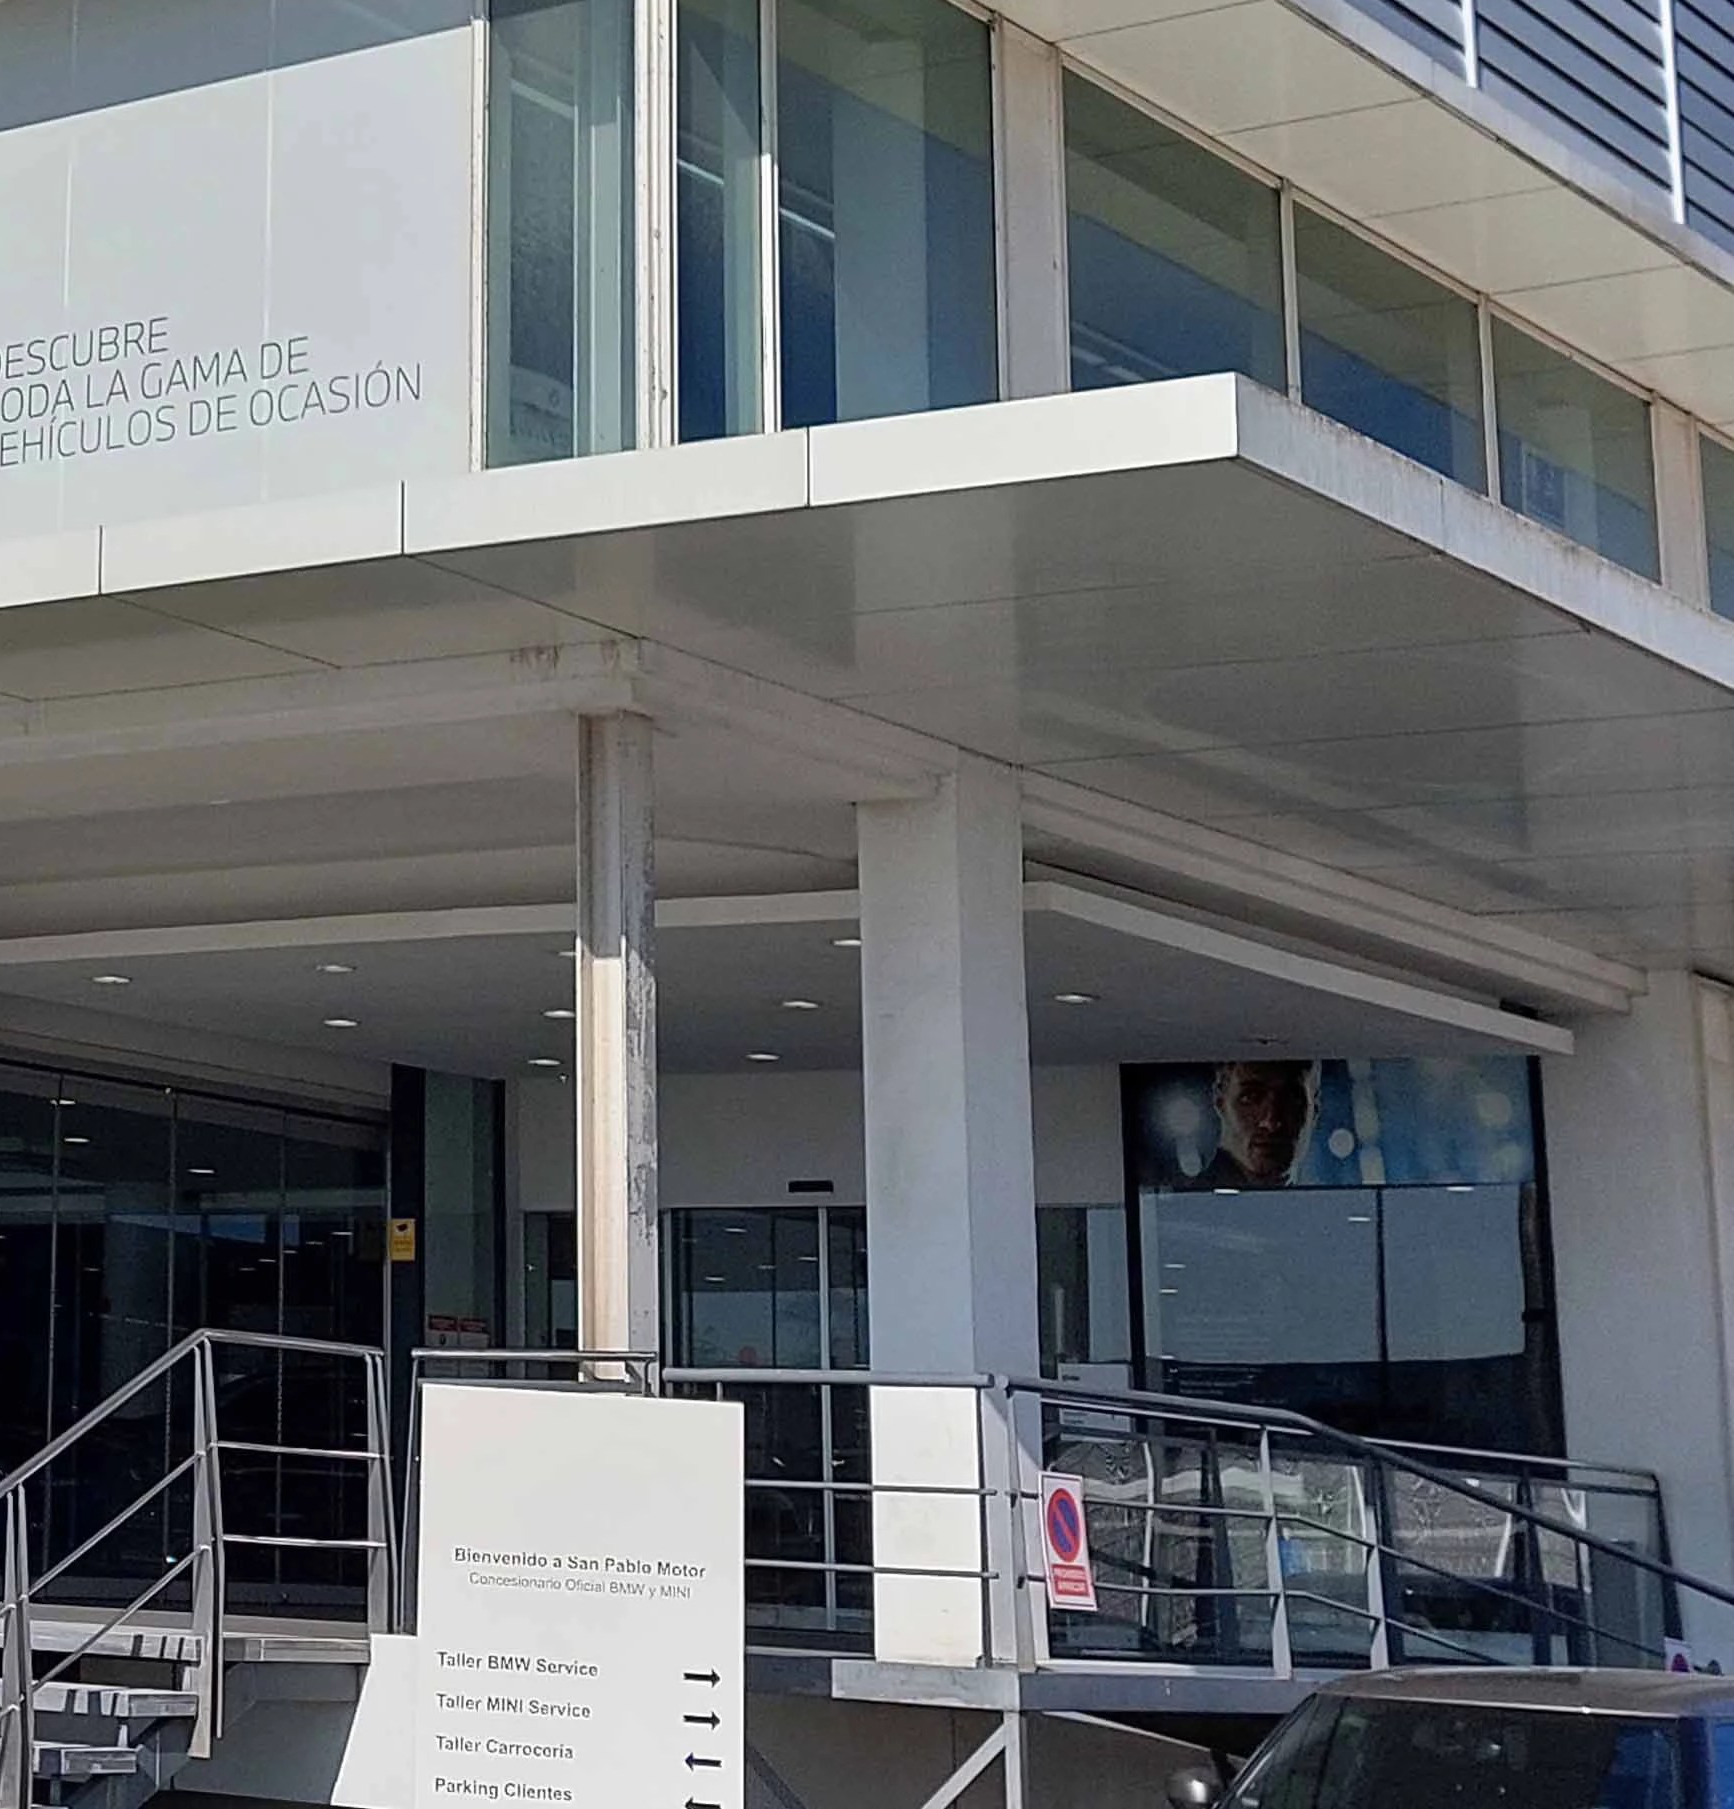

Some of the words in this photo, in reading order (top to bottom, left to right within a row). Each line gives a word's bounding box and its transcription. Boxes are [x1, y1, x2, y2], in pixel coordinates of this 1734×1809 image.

[86, 368, 129, 410] LA
[141, 349, 248, 400] GAMA
[260, 336, 309, 379] DE
[189, 394, 238, 437] DE
[250, 360, 423, 426] OCASIÓN
[454, 1548, 548, 1568] Bienvenido
[552, 1557, 562, 1569] a
[567, 1555, 599, 1571] San
[605, 1558, 652, 1574] Pablo
[657, 1562, 706, 1578] Motor
[469, 1572, 561, 1590] Concesionario
[565, 1578, 606, 1592] Oficial
[610, 1581, 645, 1595] BMW
[648, 1586, 657, 1598] y
[660, 1586, 691, 1599] MINI
[437, 1651, 482, 1669] Taller
[488, 1655, 531, 1671] BMW
[536, 1658, 599, 1676] Service
[436, 1693, 482, 1712] Taller
[487, 1696, 523, 1713] MINI
[529, 1700, 591, 1718] Service
[436, 1735, 481, 1752] Taller
[435, 1777, 499, 1800] Parking
[504, 1782, 573, 1801] Clientes
